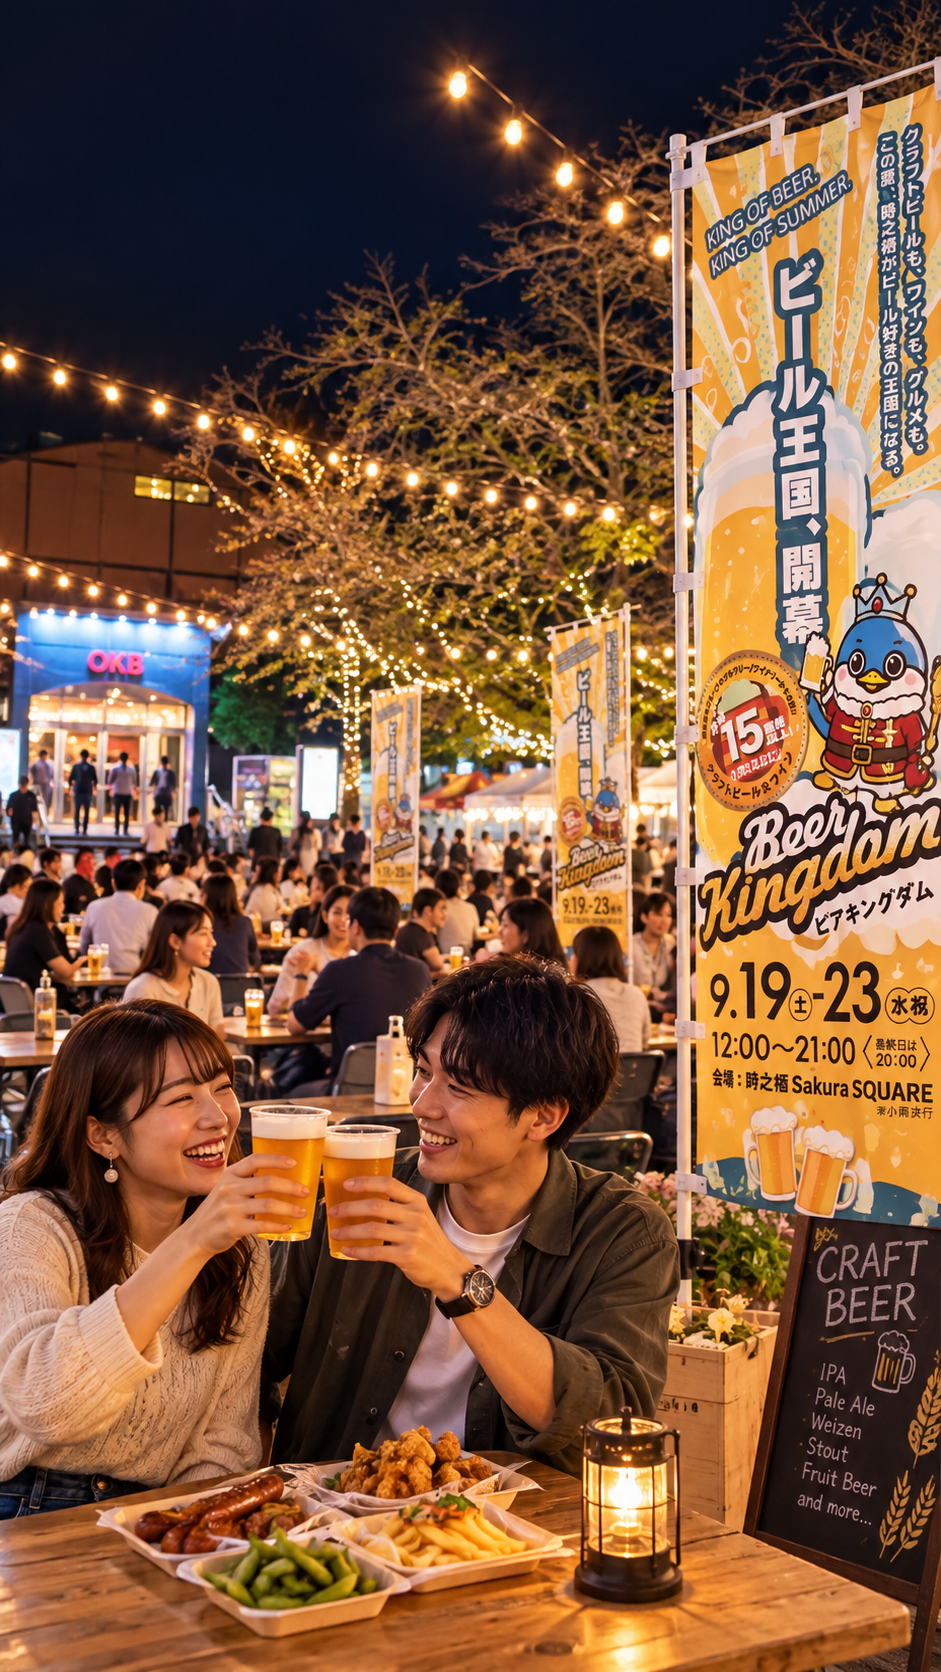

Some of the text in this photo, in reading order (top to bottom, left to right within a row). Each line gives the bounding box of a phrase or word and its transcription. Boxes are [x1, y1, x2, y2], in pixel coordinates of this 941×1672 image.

[707, 167, 818, 250] KING OF BEER.
[711, 174, 851, 276] KING OF SUMMER.
[87, 648, 144, 676] OKB
[720, 706, 764, 764] 15
[743, 798, 848, 874] Beer
[701, 805, 941, 942] Kingdom
[815, 880, 934, 935] ビアキングダム
[792, 1075, 849, 1098] Sakura
[852, 1080, 934, 1104] SQUARE
[816, 1240, 928, 1283] CRAFT
[825, 1282, 916, 1327] BEER
[820, 1363, 846, 1385] IPA
[815, 1387, 875, 1417] Pale Ale
[811, 1412, 861, 1440] Weizen
[807, 1437, 849, 1463] Stout
[801, 1462, 877, 1497] Fruit Beer
[797, 1492, 872, 1525] and more...
